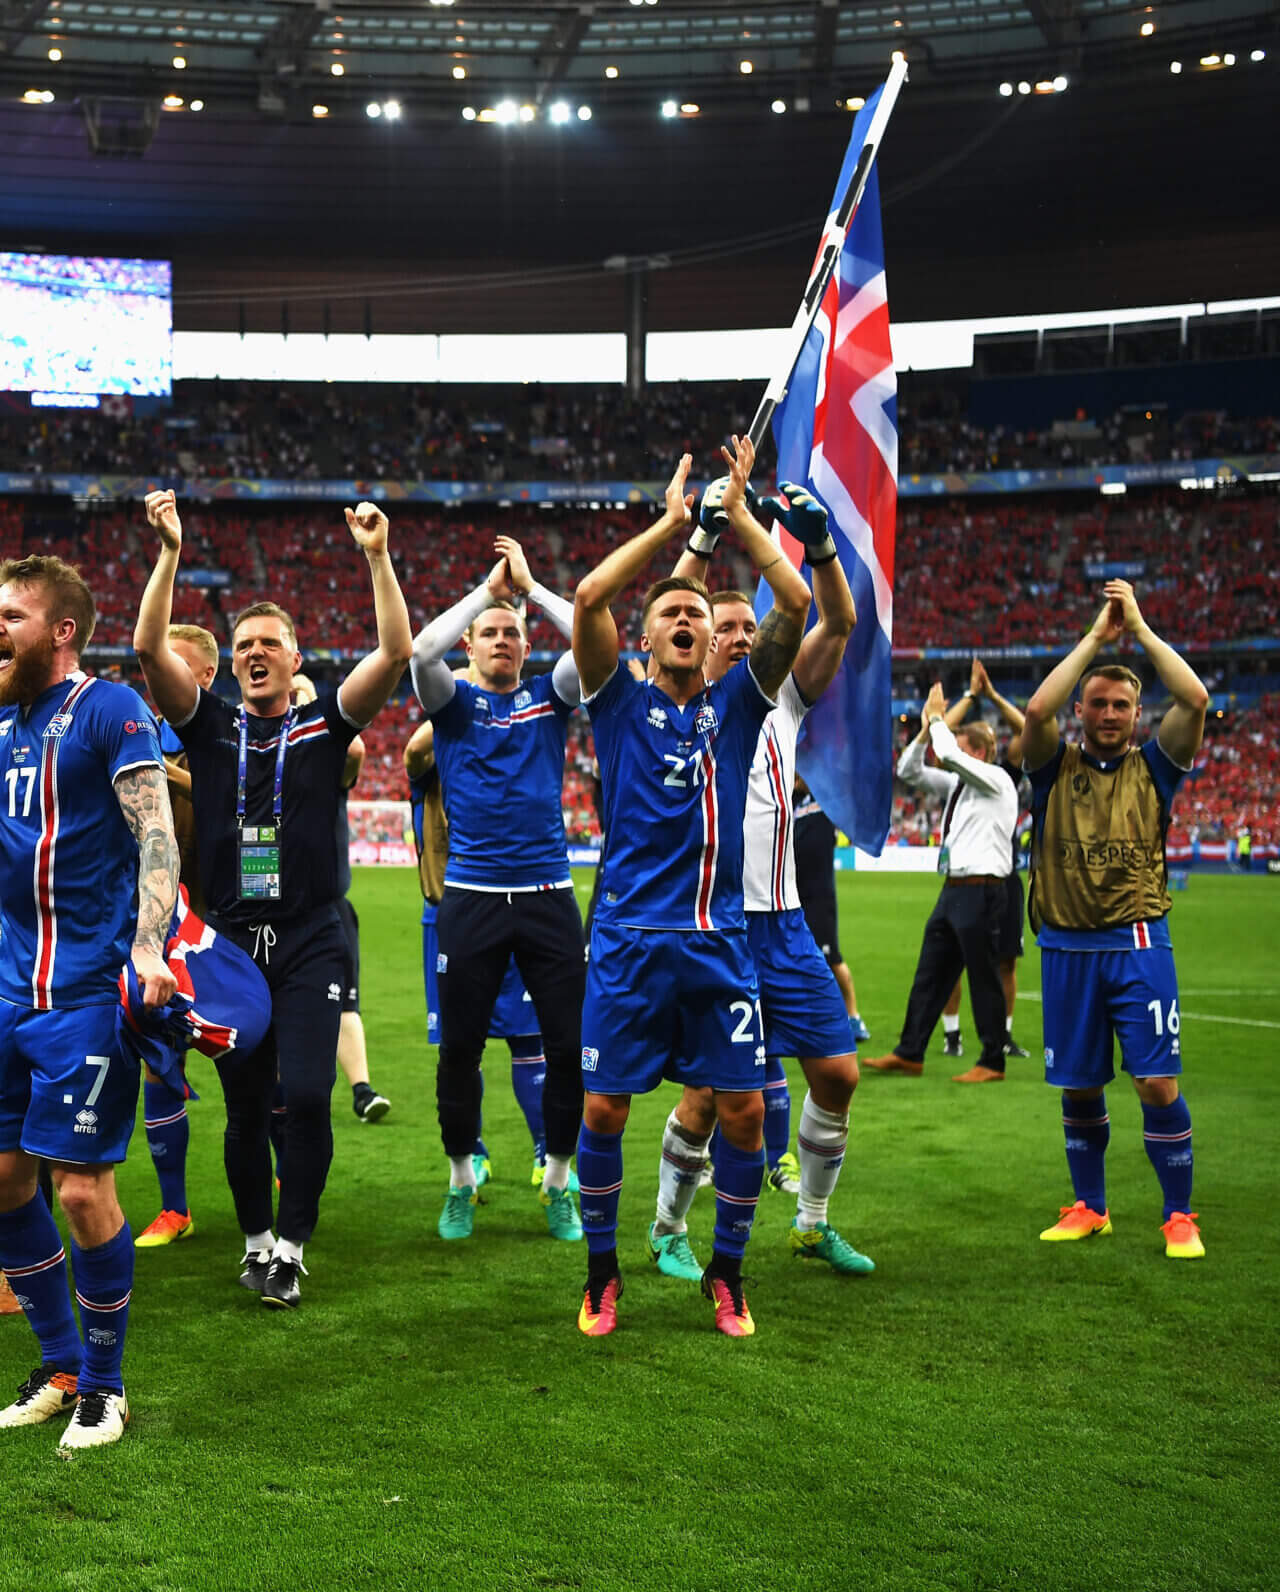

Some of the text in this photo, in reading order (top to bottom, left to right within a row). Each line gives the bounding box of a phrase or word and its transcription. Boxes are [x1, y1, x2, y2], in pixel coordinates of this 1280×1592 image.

[663, 748, 704, 788] 21
[4, 766, 38, 818] 17
[1147, 998, 1181, 1037] 16
